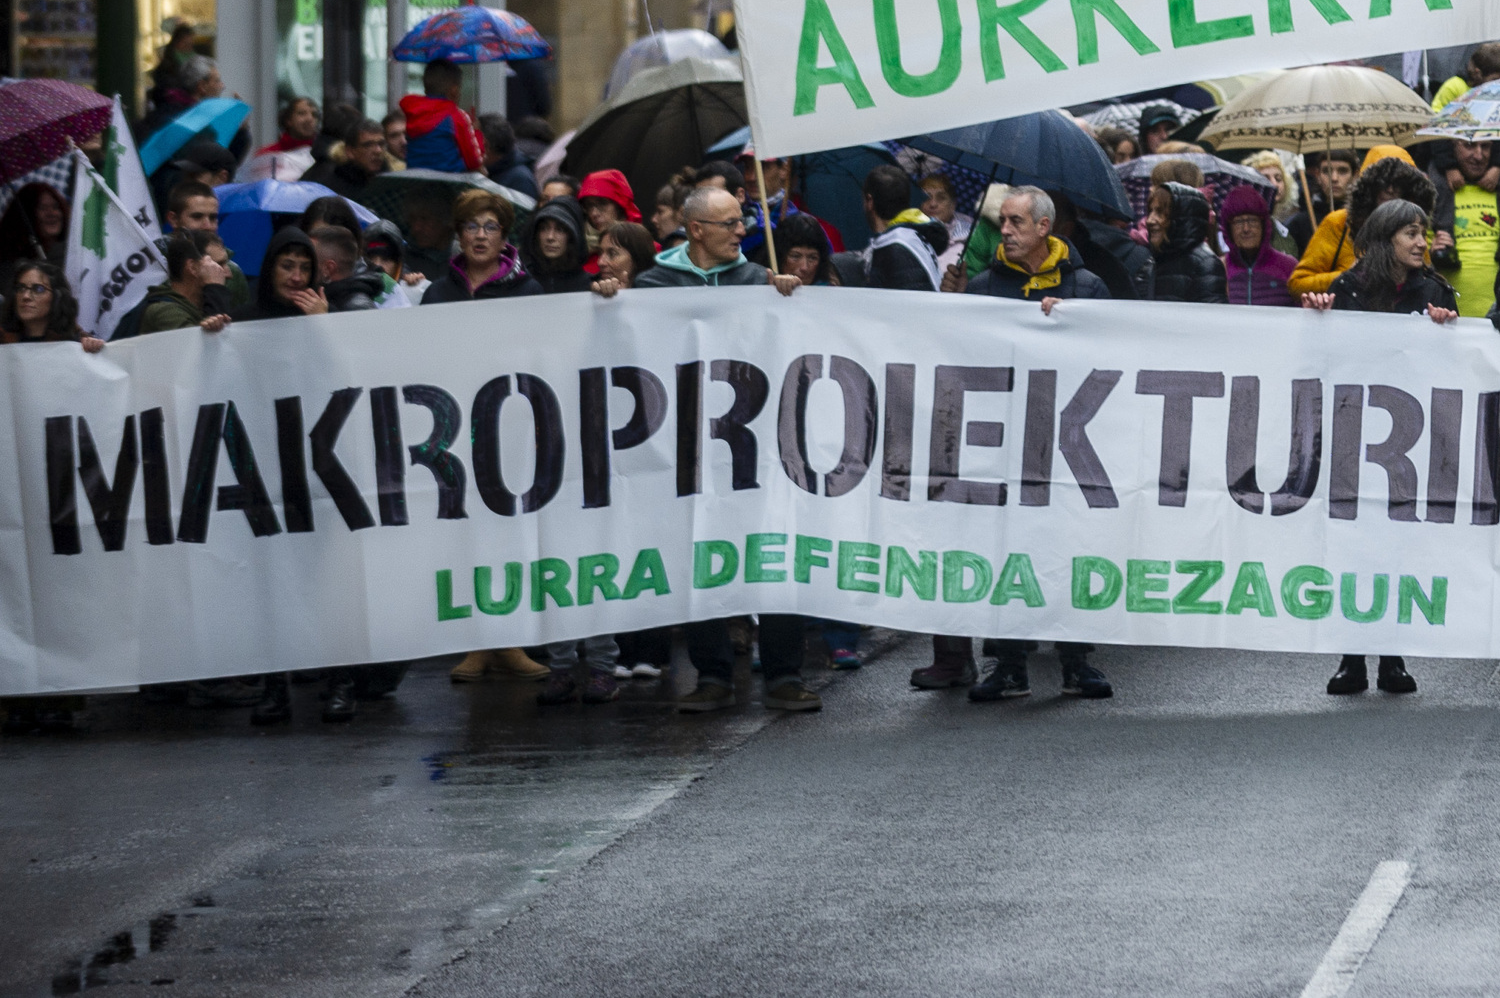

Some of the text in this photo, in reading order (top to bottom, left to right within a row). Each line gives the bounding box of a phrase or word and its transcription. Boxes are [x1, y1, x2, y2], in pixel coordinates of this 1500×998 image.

[435, 532, 1449, 627] LURRA DEFENDA DEZAGUN
